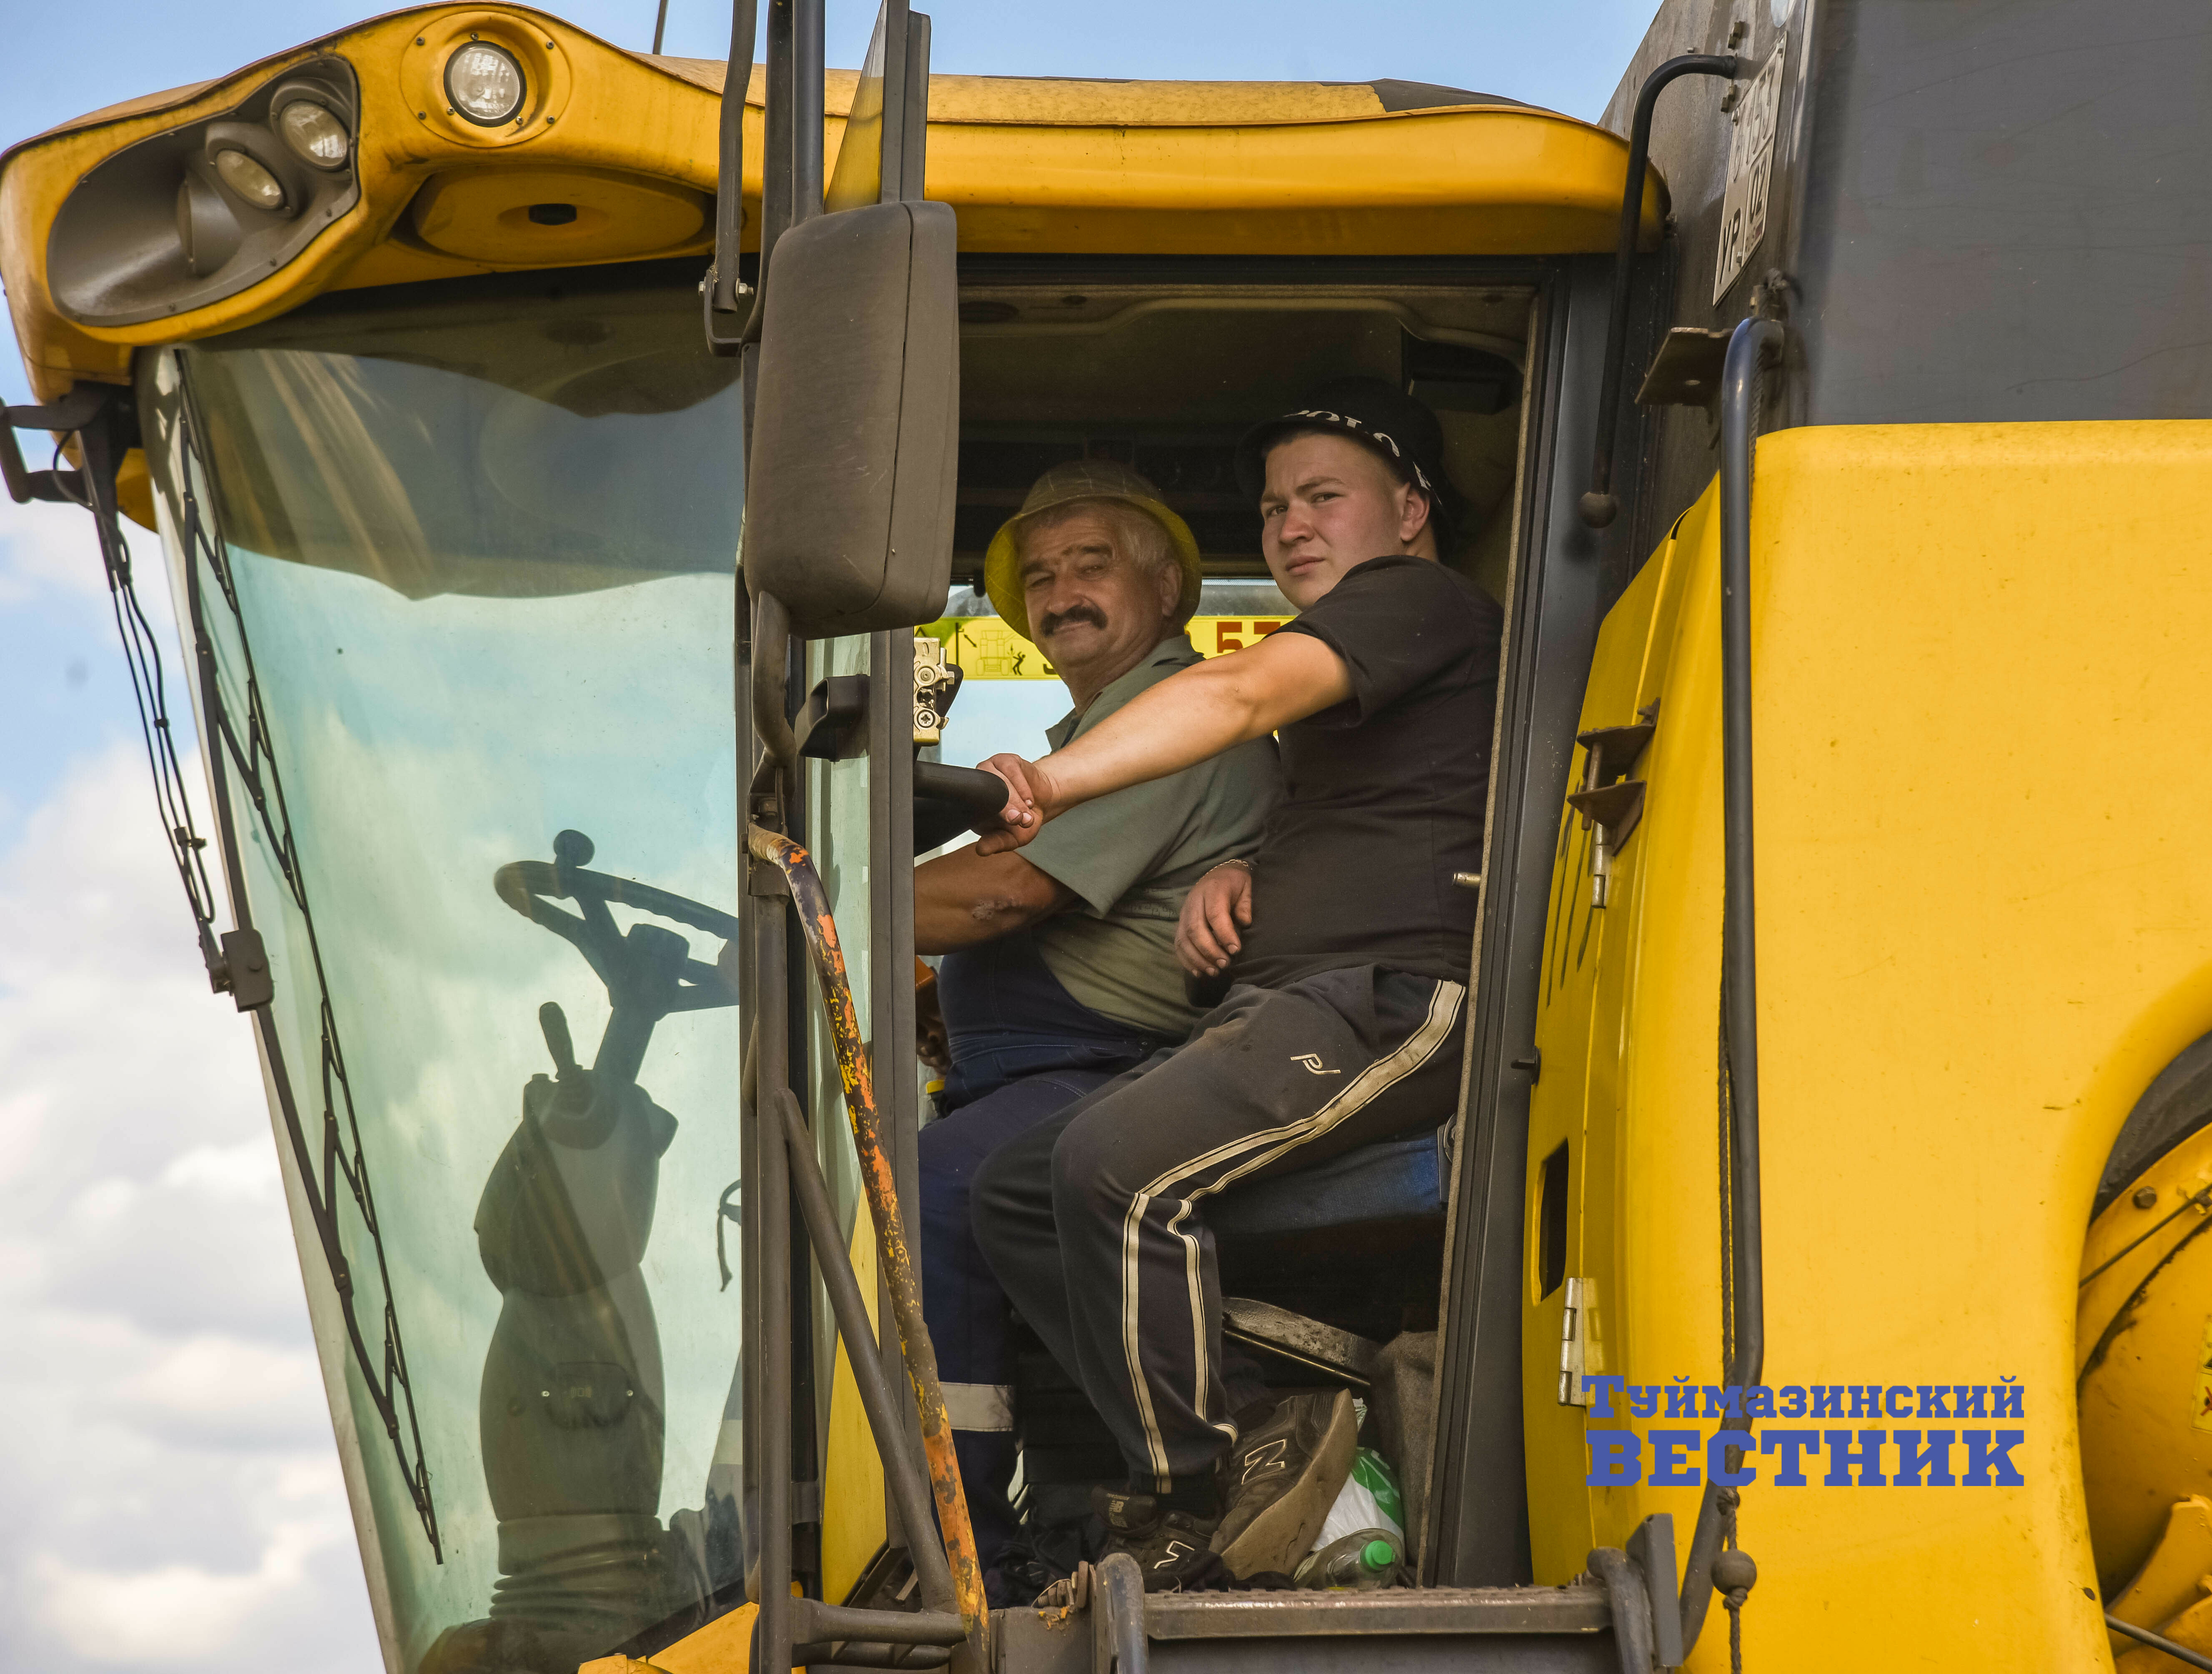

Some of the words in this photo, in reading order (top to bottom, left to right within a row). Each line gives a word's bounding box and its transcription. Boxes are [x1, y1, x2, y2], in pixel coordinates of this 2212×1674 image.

[1733, 58, 1776, 182] 6153
[1749, 153, 1767, 224] 02
[1744, 227, 1756, 256] RUS
